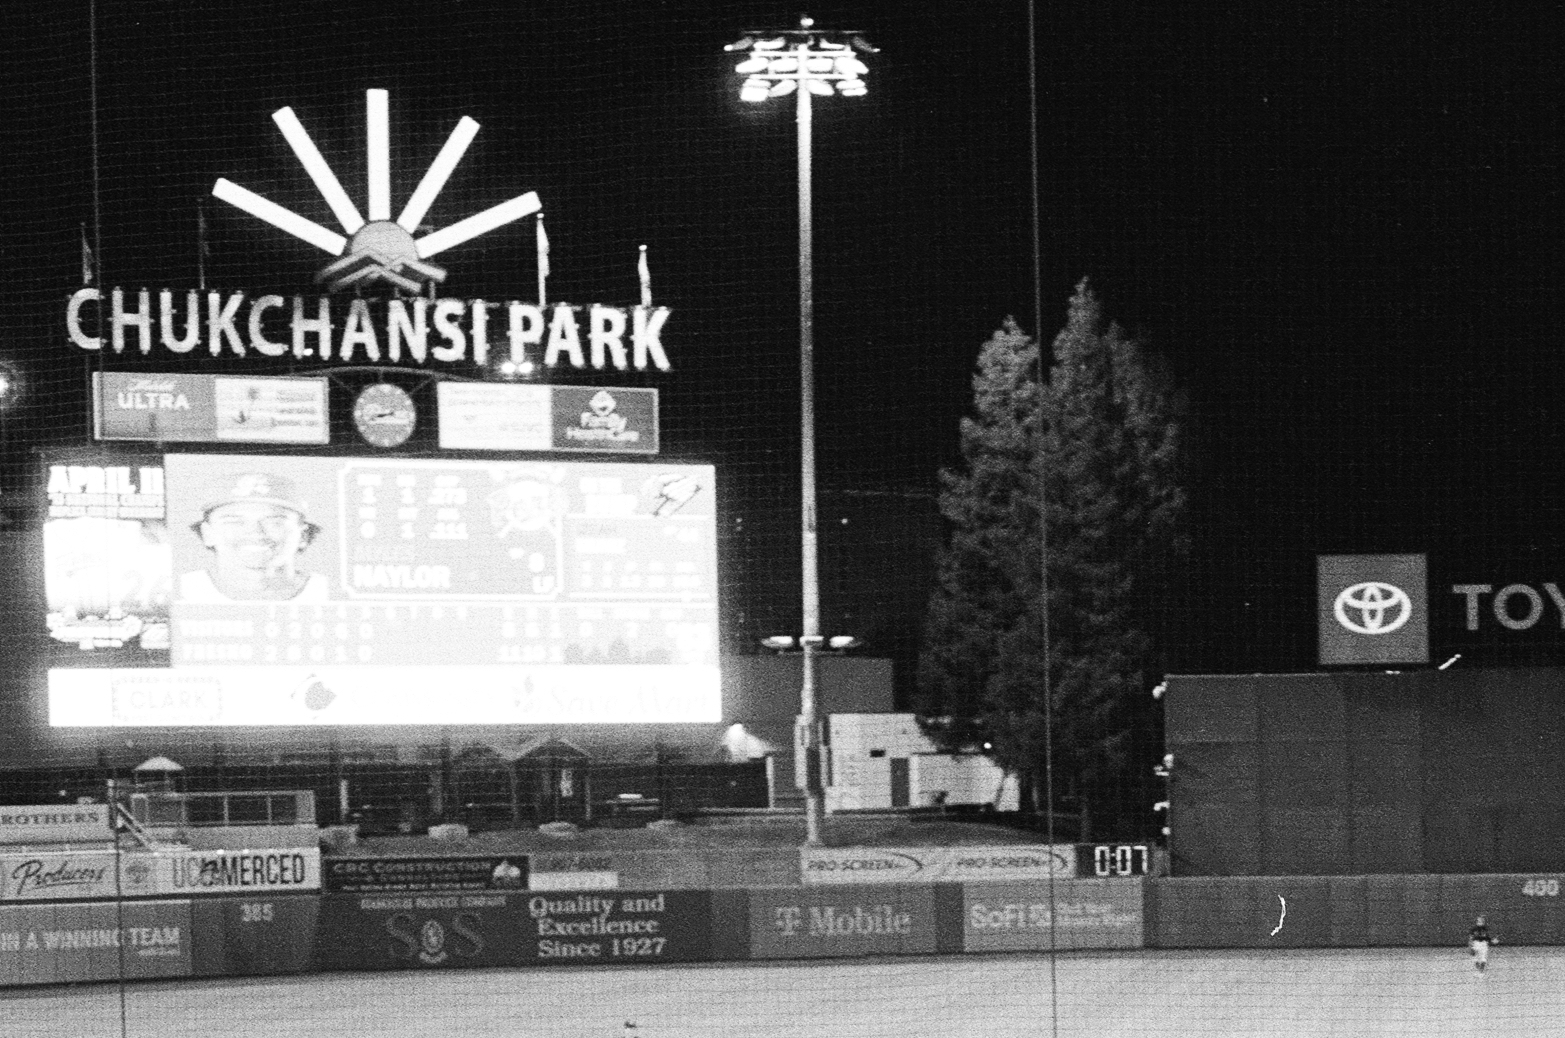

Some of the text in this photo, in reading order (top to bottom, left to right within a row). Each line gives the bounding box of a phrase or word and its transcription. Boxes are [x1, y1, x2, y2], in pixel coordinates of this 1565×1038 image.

[66, 285, 671, 372] CHUKCHANSI PARK
[117, 391, 191, 410] ULTRA
[353, 563, 452, 589] NAYLOR
[129, 689, 207, 710] CLARK
[172, 856, 203, 888] UC
[219, 853, 306, 887] MERCED
[1094, 845, 1149, 876] 0:07
[529, 895, 616, 919] Quality
[622, 893, 666, 912] and
[970, 902, 1027, 928] SoFi
[537, 916, 661, 937] Excellence
[808, 903, 912, 937] Mobile
[130, 925, 180, 946] TEAM
[537, 937, 668, 958] Since 1927
